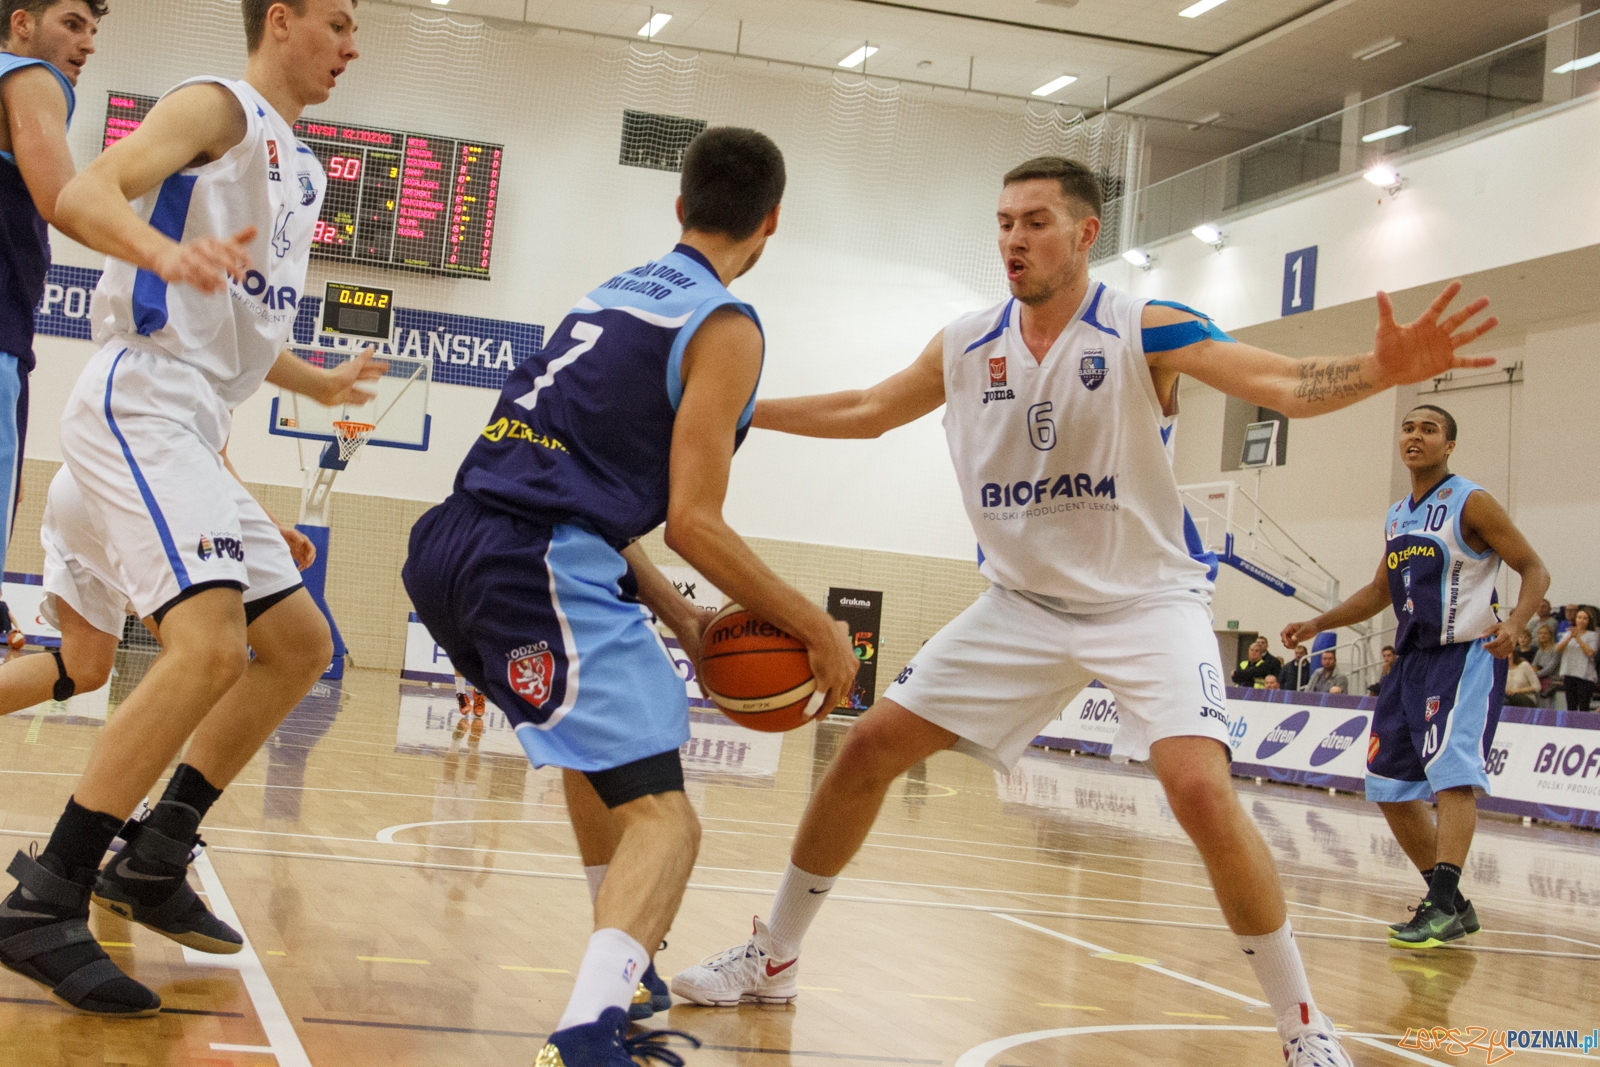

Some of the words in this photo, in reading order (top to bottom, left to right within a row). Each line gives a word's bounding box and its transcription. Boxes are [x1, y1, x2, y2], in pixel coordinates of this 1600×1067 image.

[307, 123, 337, 138] NYSA
[463, 146, 469, 155] 5
[493, 150, 500, 158] 0
[328, 156, 360, 180] 50
[492, 160, 499, 169] 0
[389, 167, 398, 178] 3
[491, 170, 498, 178] 0
[490, 180, 497, 188] 0
[489, 190, 496, 198] 0
[386, 200, 395, 211] 4
[488, 200, 494, 208] 0
[486, 210, 493, 218] 0
[345, 224, 354, 235] 4
[485, 220, 492, 228] 0
[484, 230, 491, 238] 0
[483, 240, 490, 248] 0
[482, 249, 489, 258] 0
[450, 255, 457, 263] 0
[480, 259, 488, 268] 0
[652, 265, 697, 289] DORAL
[1290, 255, 1303, 307] 1
[340, 290, 389, 308] 0.08.2
[514, 321, 604, 411] 7
[1078, 368, 1109, 377] BASKET
[1028, 401, 1057, 451] 6
[981, 473, 1117, 508] BIOFARM
[983, 511, 1019, 521] POLSKI
[1021, 501, 1086, 519] PRODUCENT
[1423, 503, 1448, 533] 10
[213, 537, 244, 562] PBG
[1240, 560, 1285, 589] PESMENPOL
[840, 597, 871, 607] drukma
[1450, 587, 1460, 607] DORAL
[1266, 725, 1296, 744] atrem
[1321, 731, 1353, 750] atrem
[1422, 723, 1438, 758] 10
[1537, 780, 1564, 790] POLSKI
